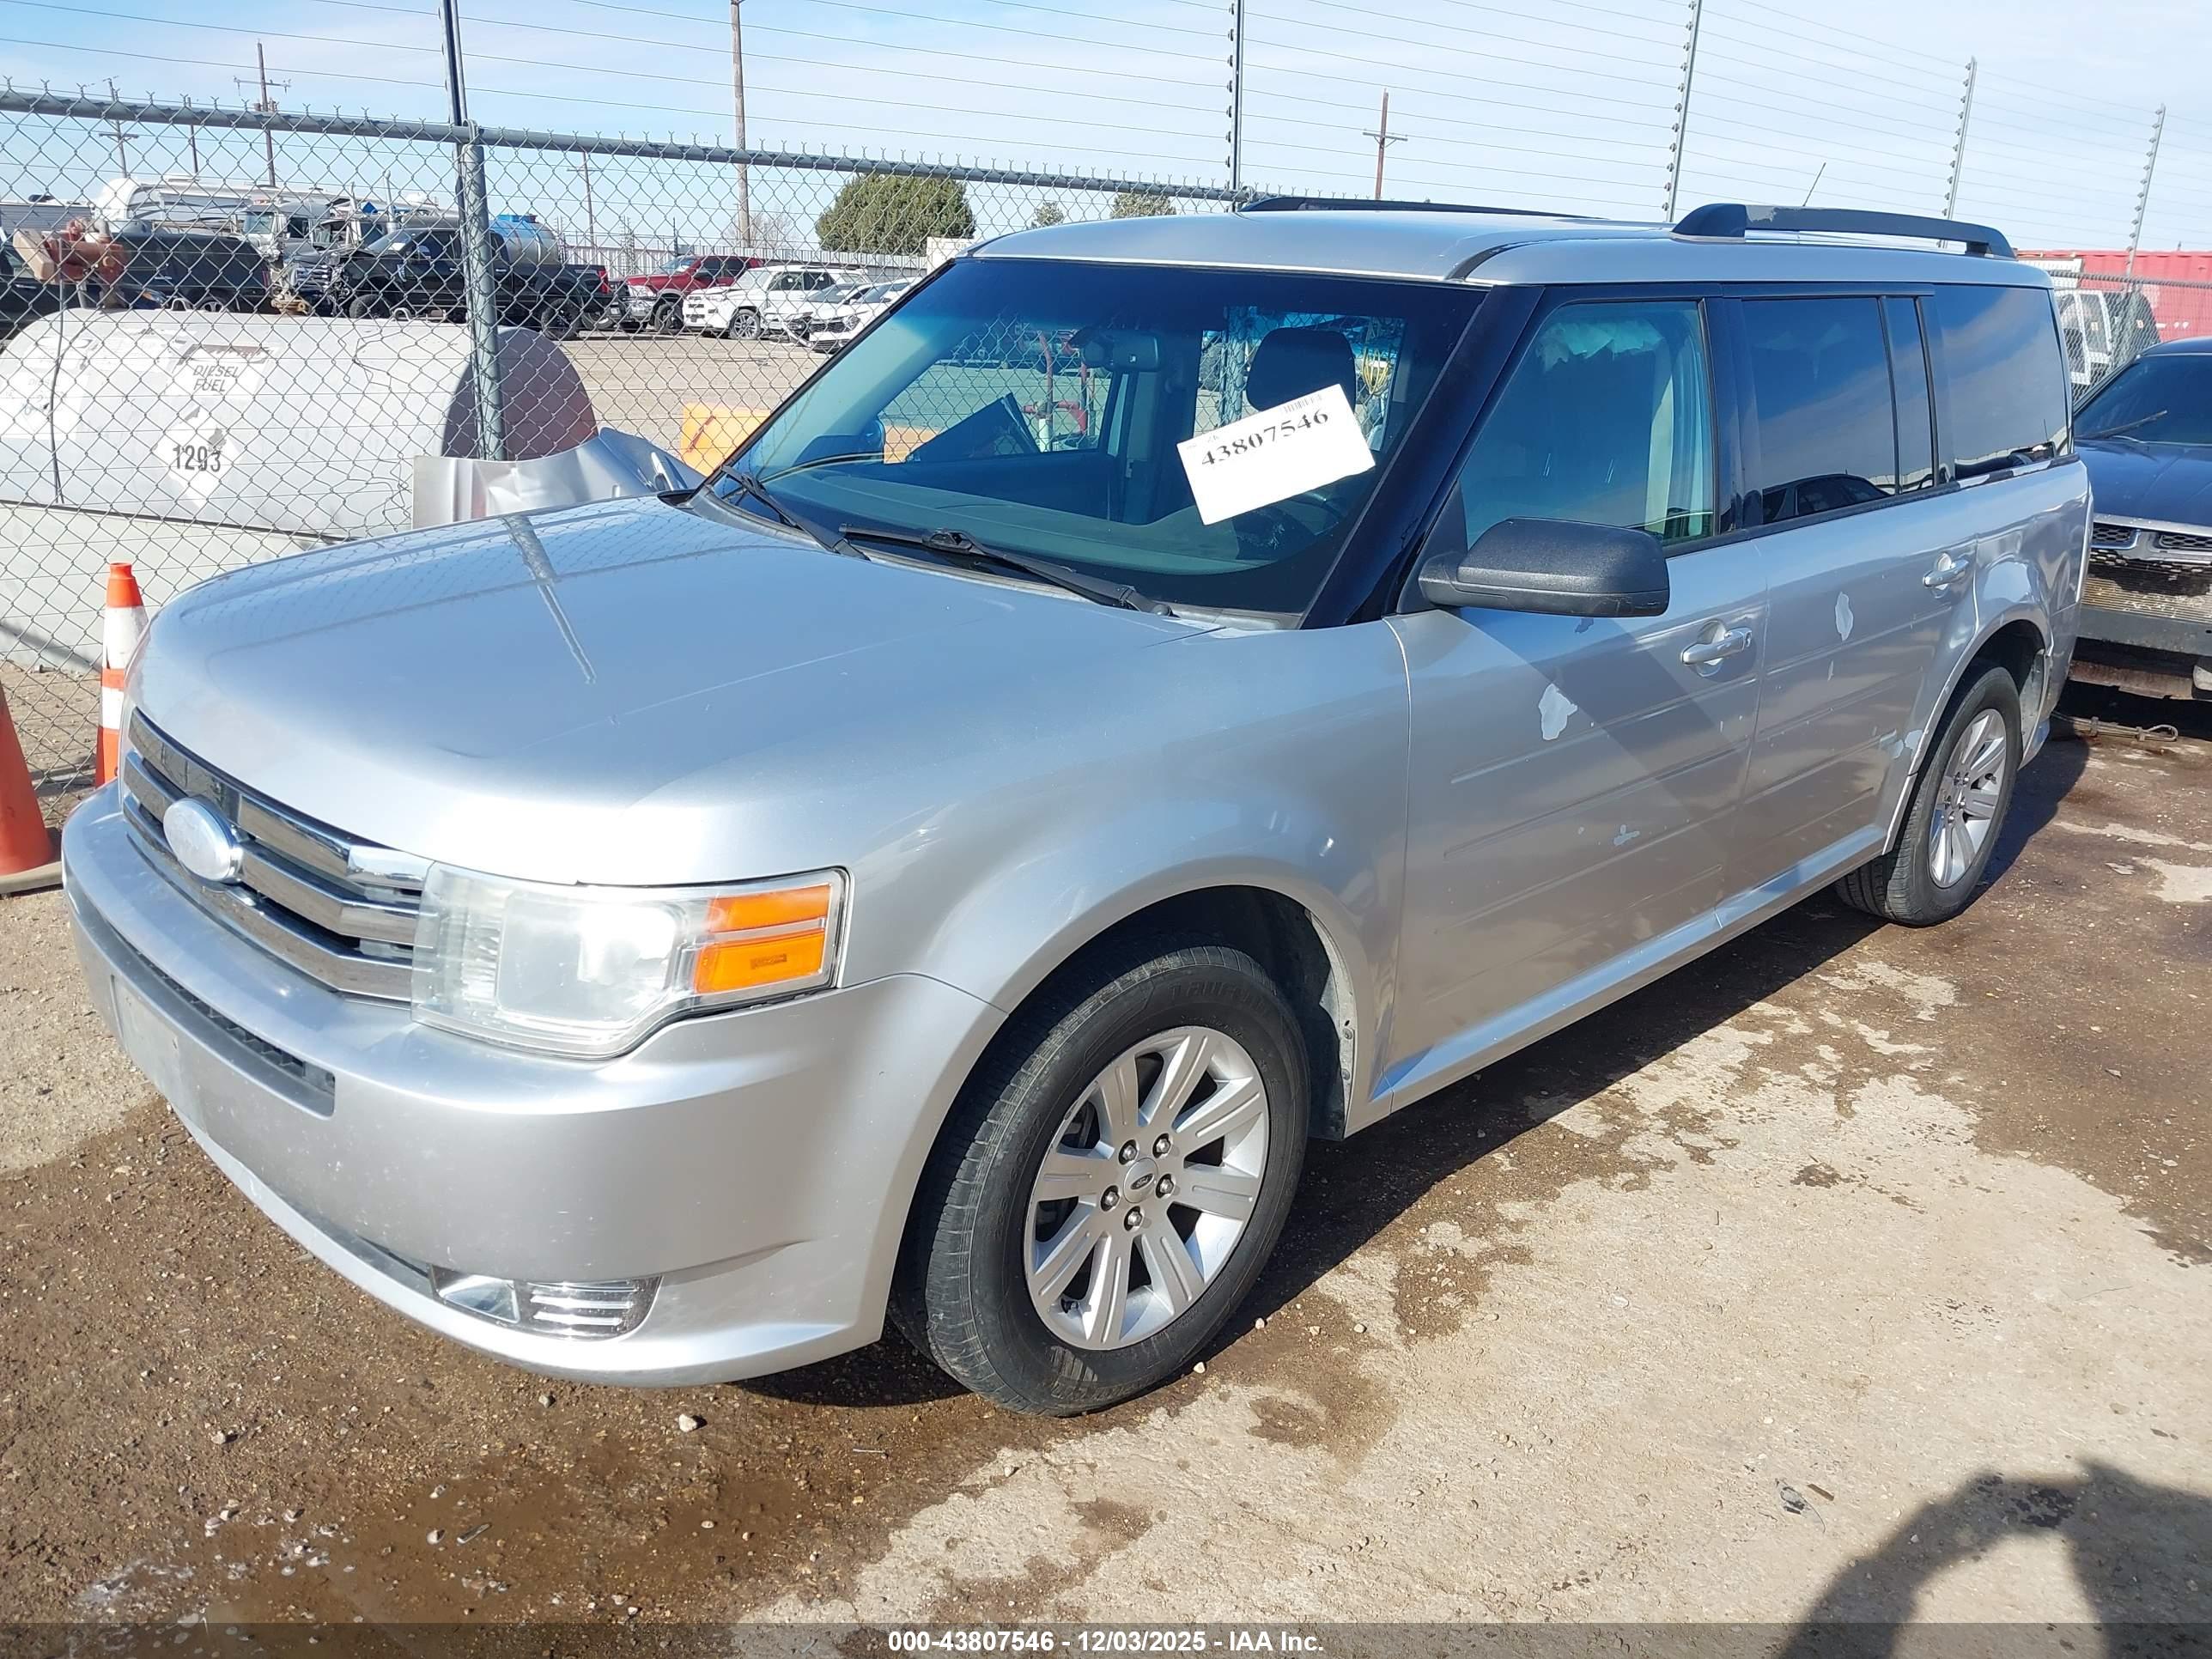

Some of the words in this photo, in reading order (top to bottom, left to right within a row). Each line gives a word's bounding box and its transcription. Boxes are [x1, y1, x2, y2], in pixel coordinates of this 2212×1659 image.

[192, 364, 239, 379] DIESEL
[193, 378, 226, 392] FUEL
[1201, 408, 1329, 465] 43807546
[173, 444, 222, 473] 1293
